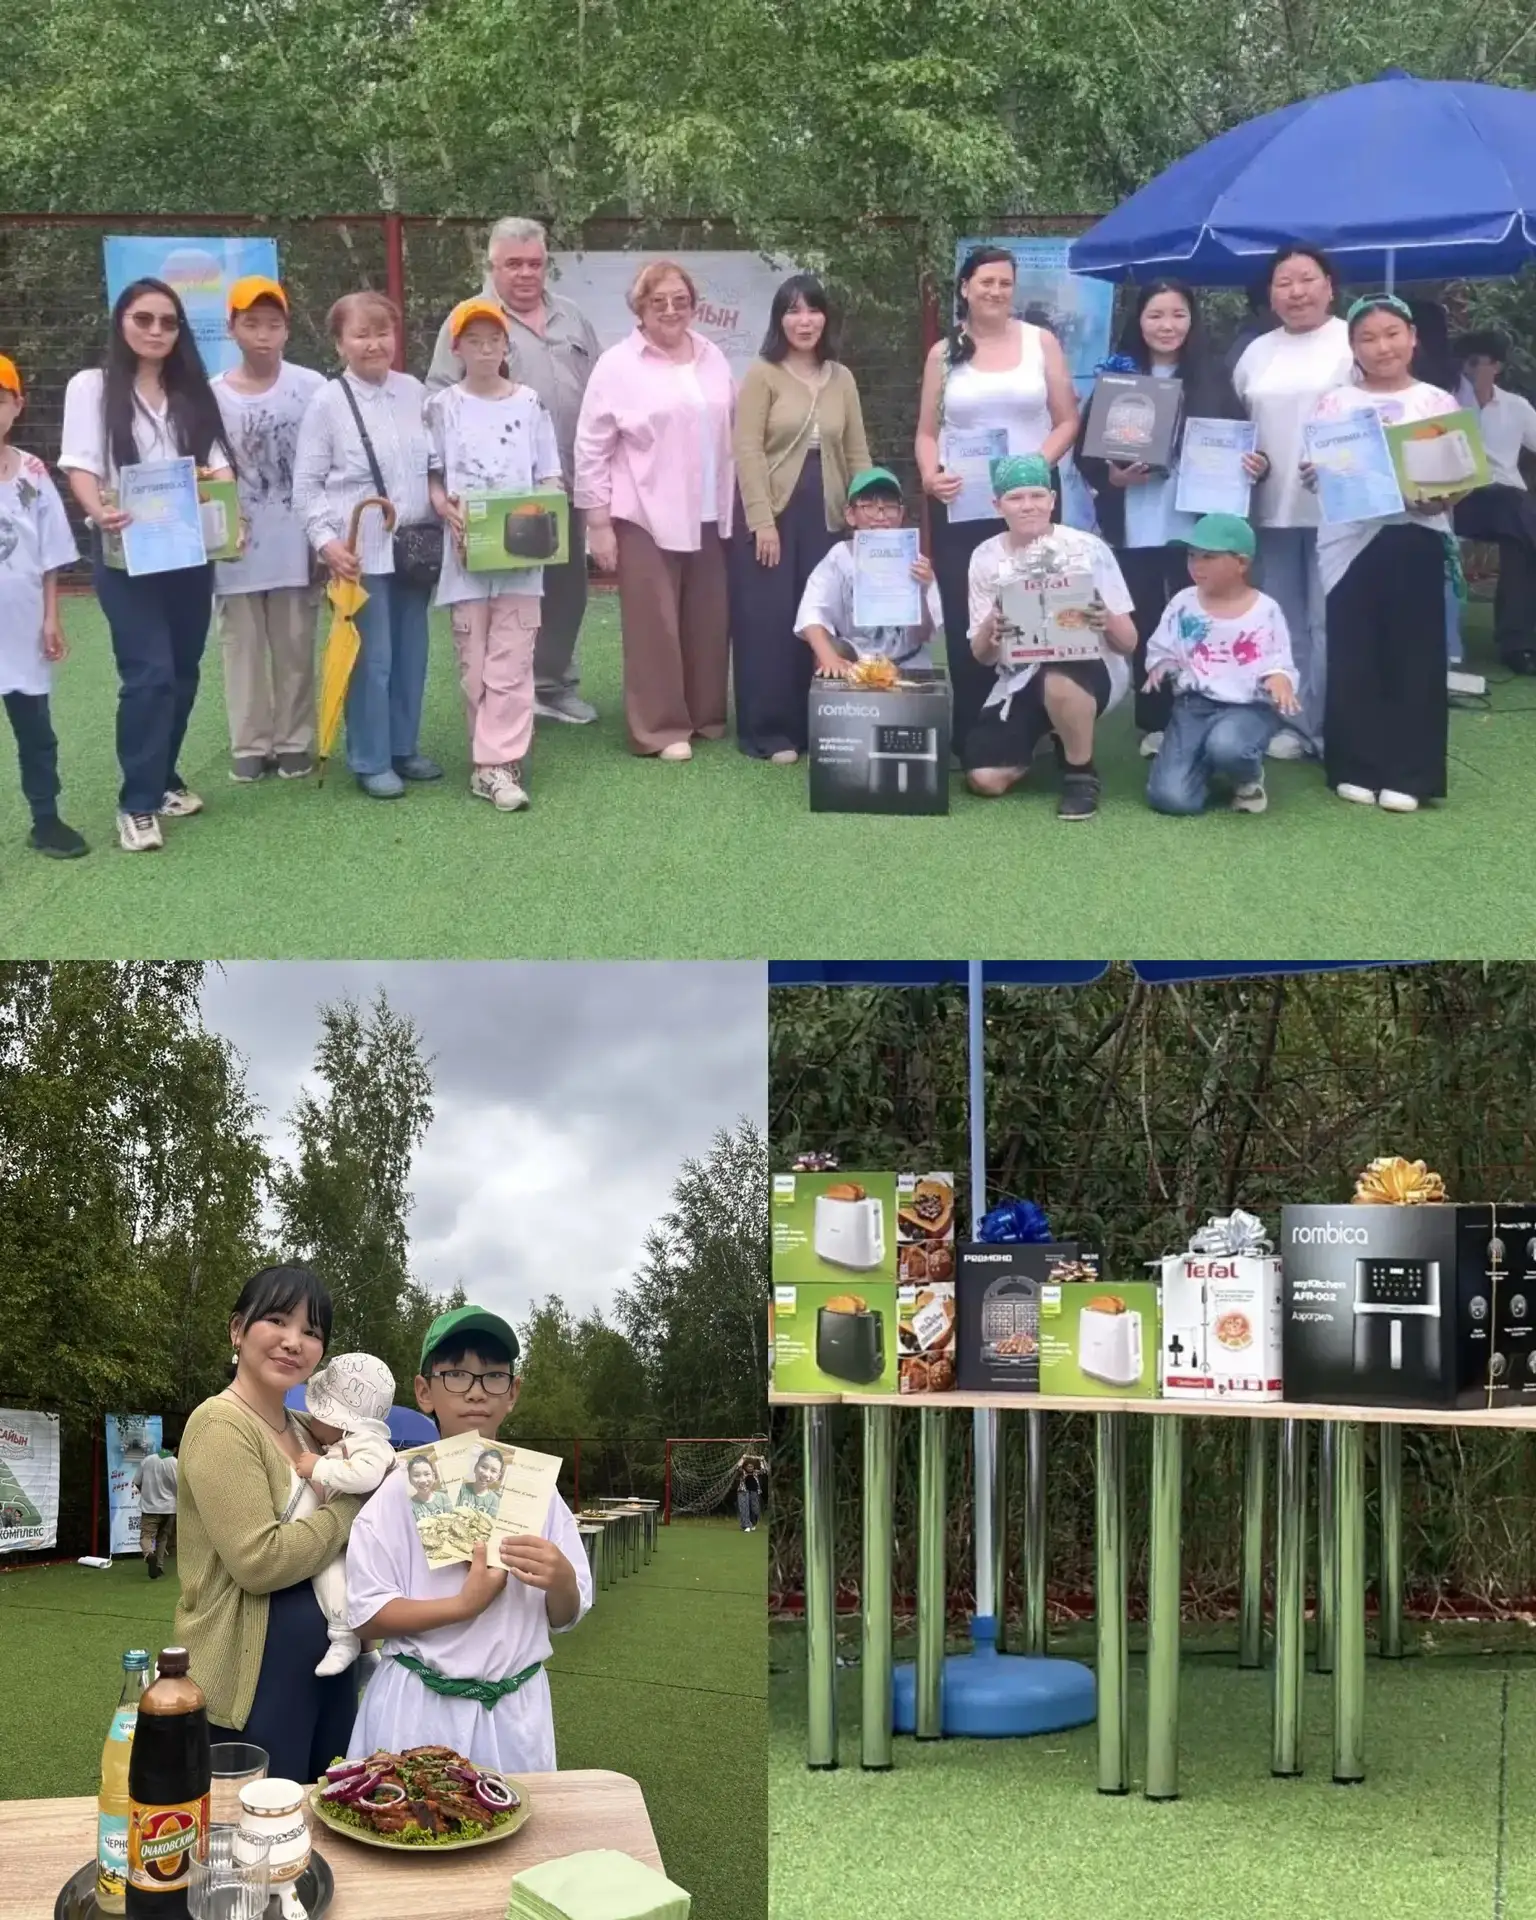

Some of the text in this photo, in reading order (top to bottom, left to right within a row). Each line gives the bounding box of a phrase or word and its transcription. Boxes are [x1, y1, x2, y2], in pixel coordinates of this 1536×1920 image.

[817, 702, 881, 718] rombica
[1291, 1220, 1369, 1245] rombica
[1183, 1261, 1240, 1279] Tefal
[1292, 1279, 1347, 1290] myKitchen
[1292, 1291, 1338, 1301] AFR-002
[1291, 1310, 1335, 1322] Аэрогриль
